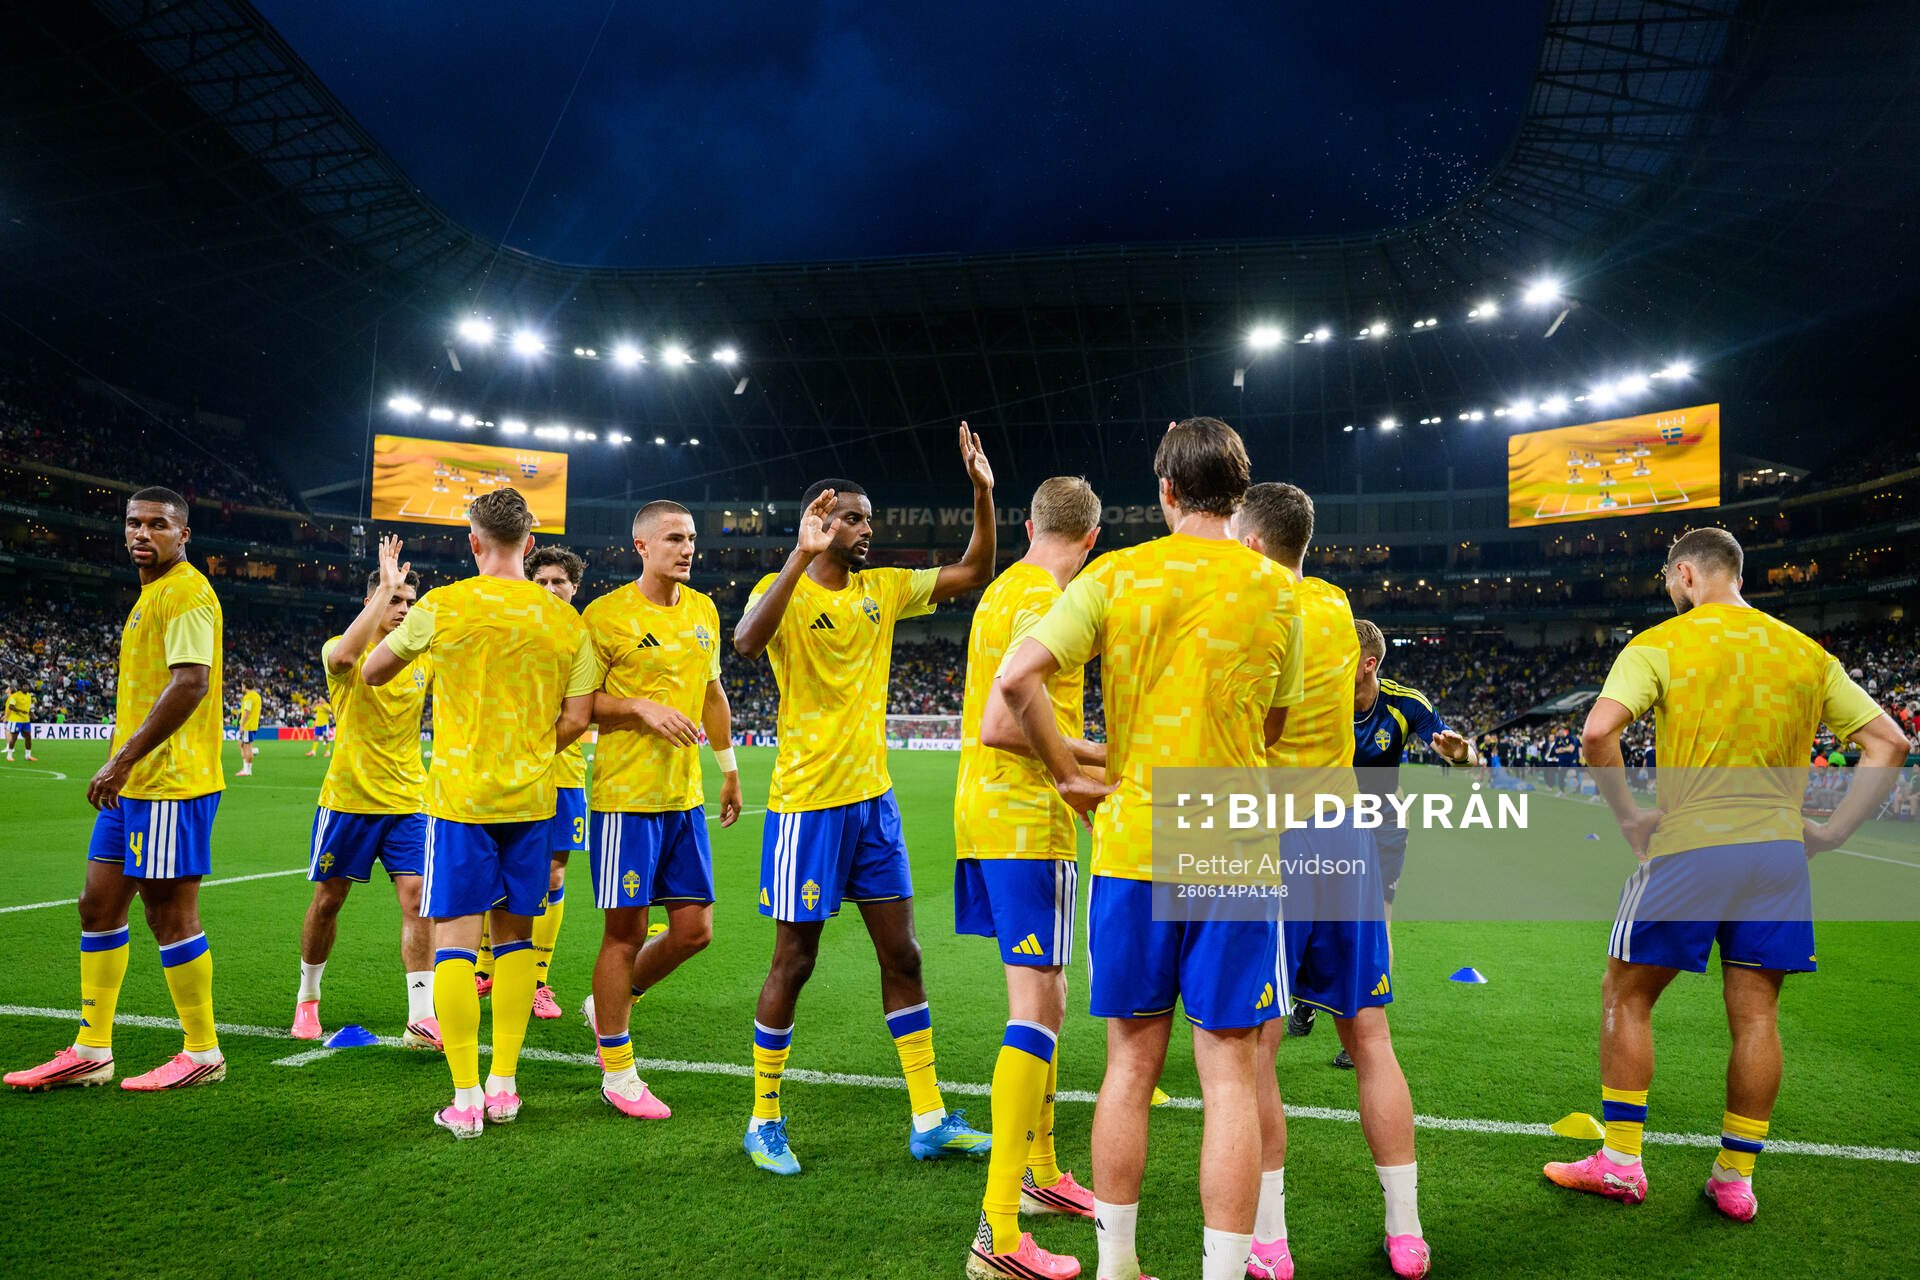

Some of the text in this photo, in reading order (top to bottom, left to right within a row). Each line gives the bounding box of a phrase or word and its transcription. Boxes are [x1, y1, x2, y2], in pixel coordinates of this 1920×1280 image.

[887, 505, 1163, 526] FIFA WOLD 026
[572, 816, 585, 844] 3
[129, 831, 144, 868] 4
